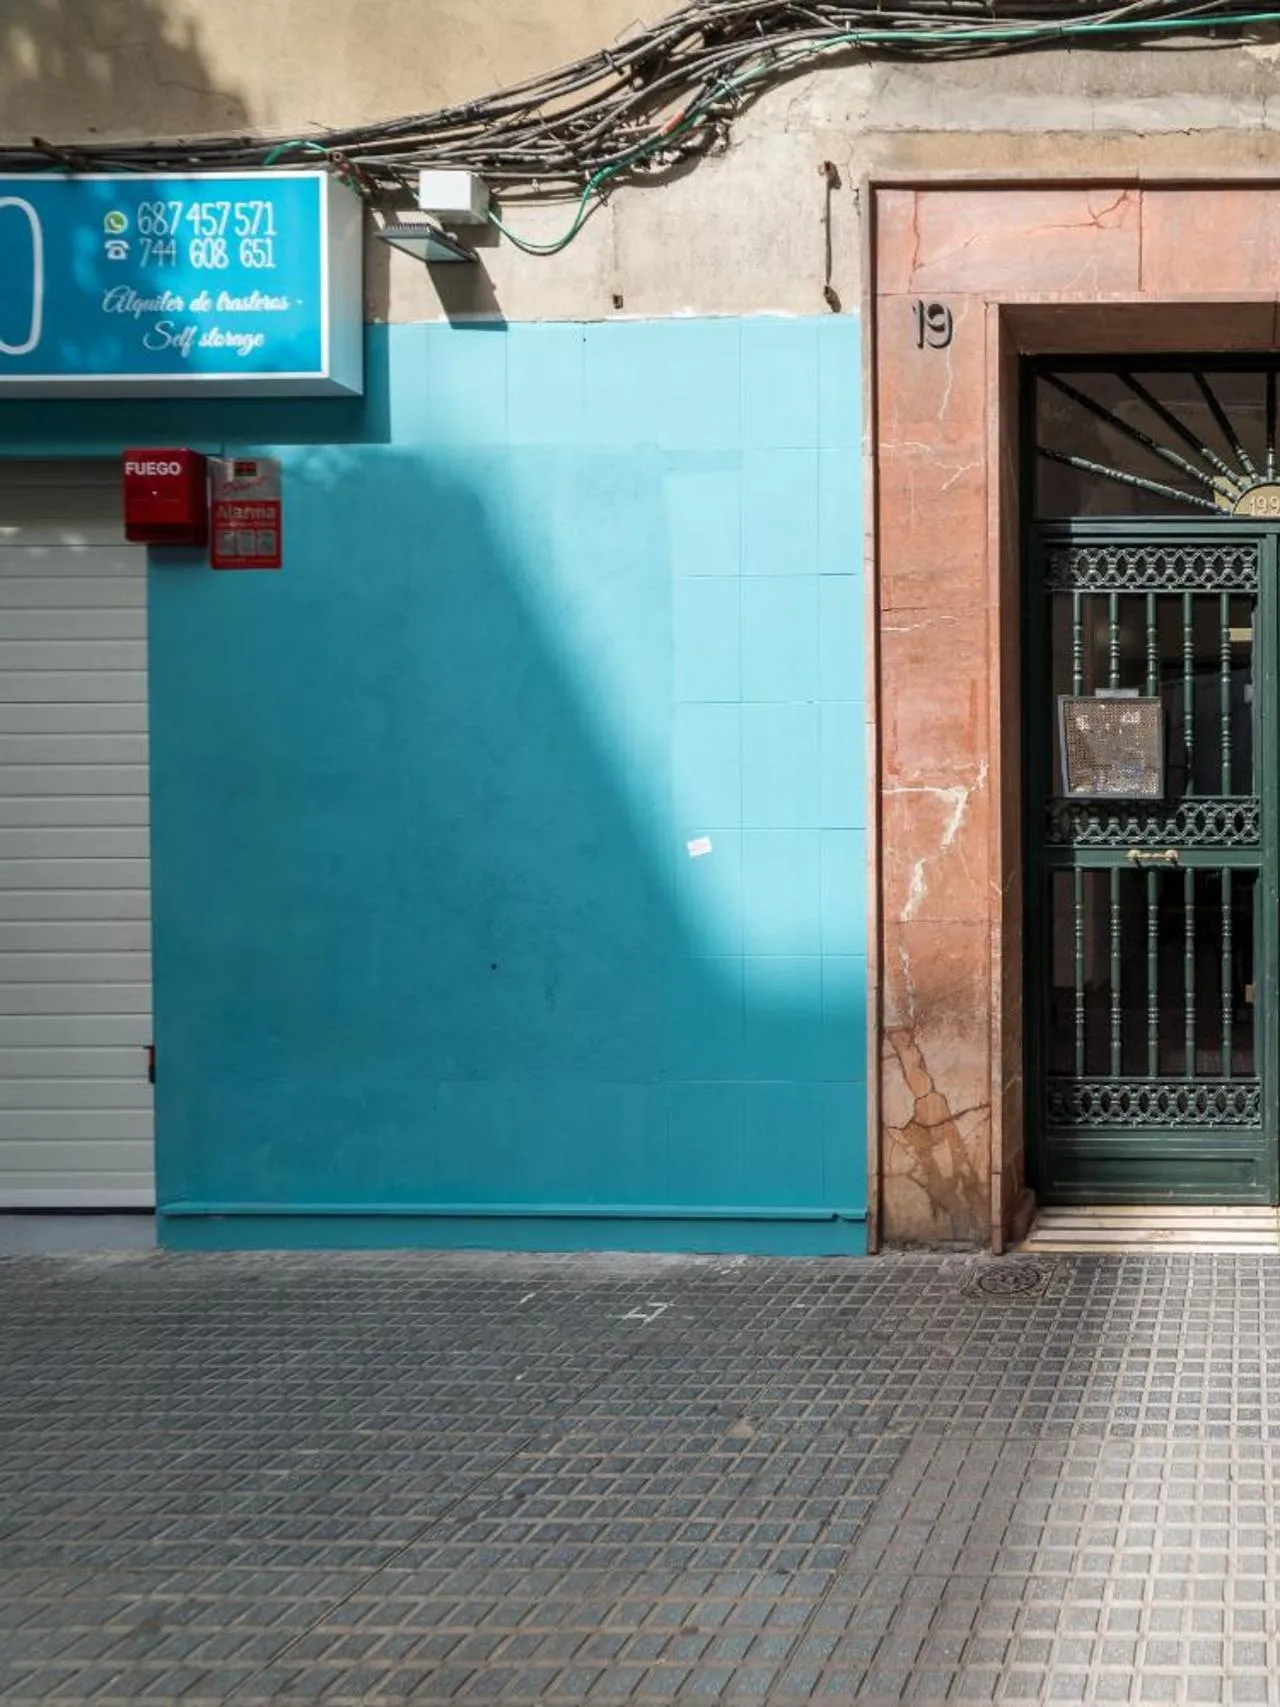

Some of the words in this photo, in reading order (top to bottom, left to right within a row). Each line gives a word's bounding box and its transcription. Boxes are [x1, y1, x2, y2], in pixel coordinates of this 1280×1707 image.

[139, 237, 178, 269] 744
[188, 237, 230, 270] 608
[239, 237, 278, 270] 651
[102, 285, 184, 320] Alquiler
[189, 290, 213, 313] de
[216, 290, 291, 313] trasteros
[142, 320, 198, 358] Self
[198, 327, 265, 356] storage
[911, 299, 954, 350] 19
[124, 461, 182, 476] FUEGO
